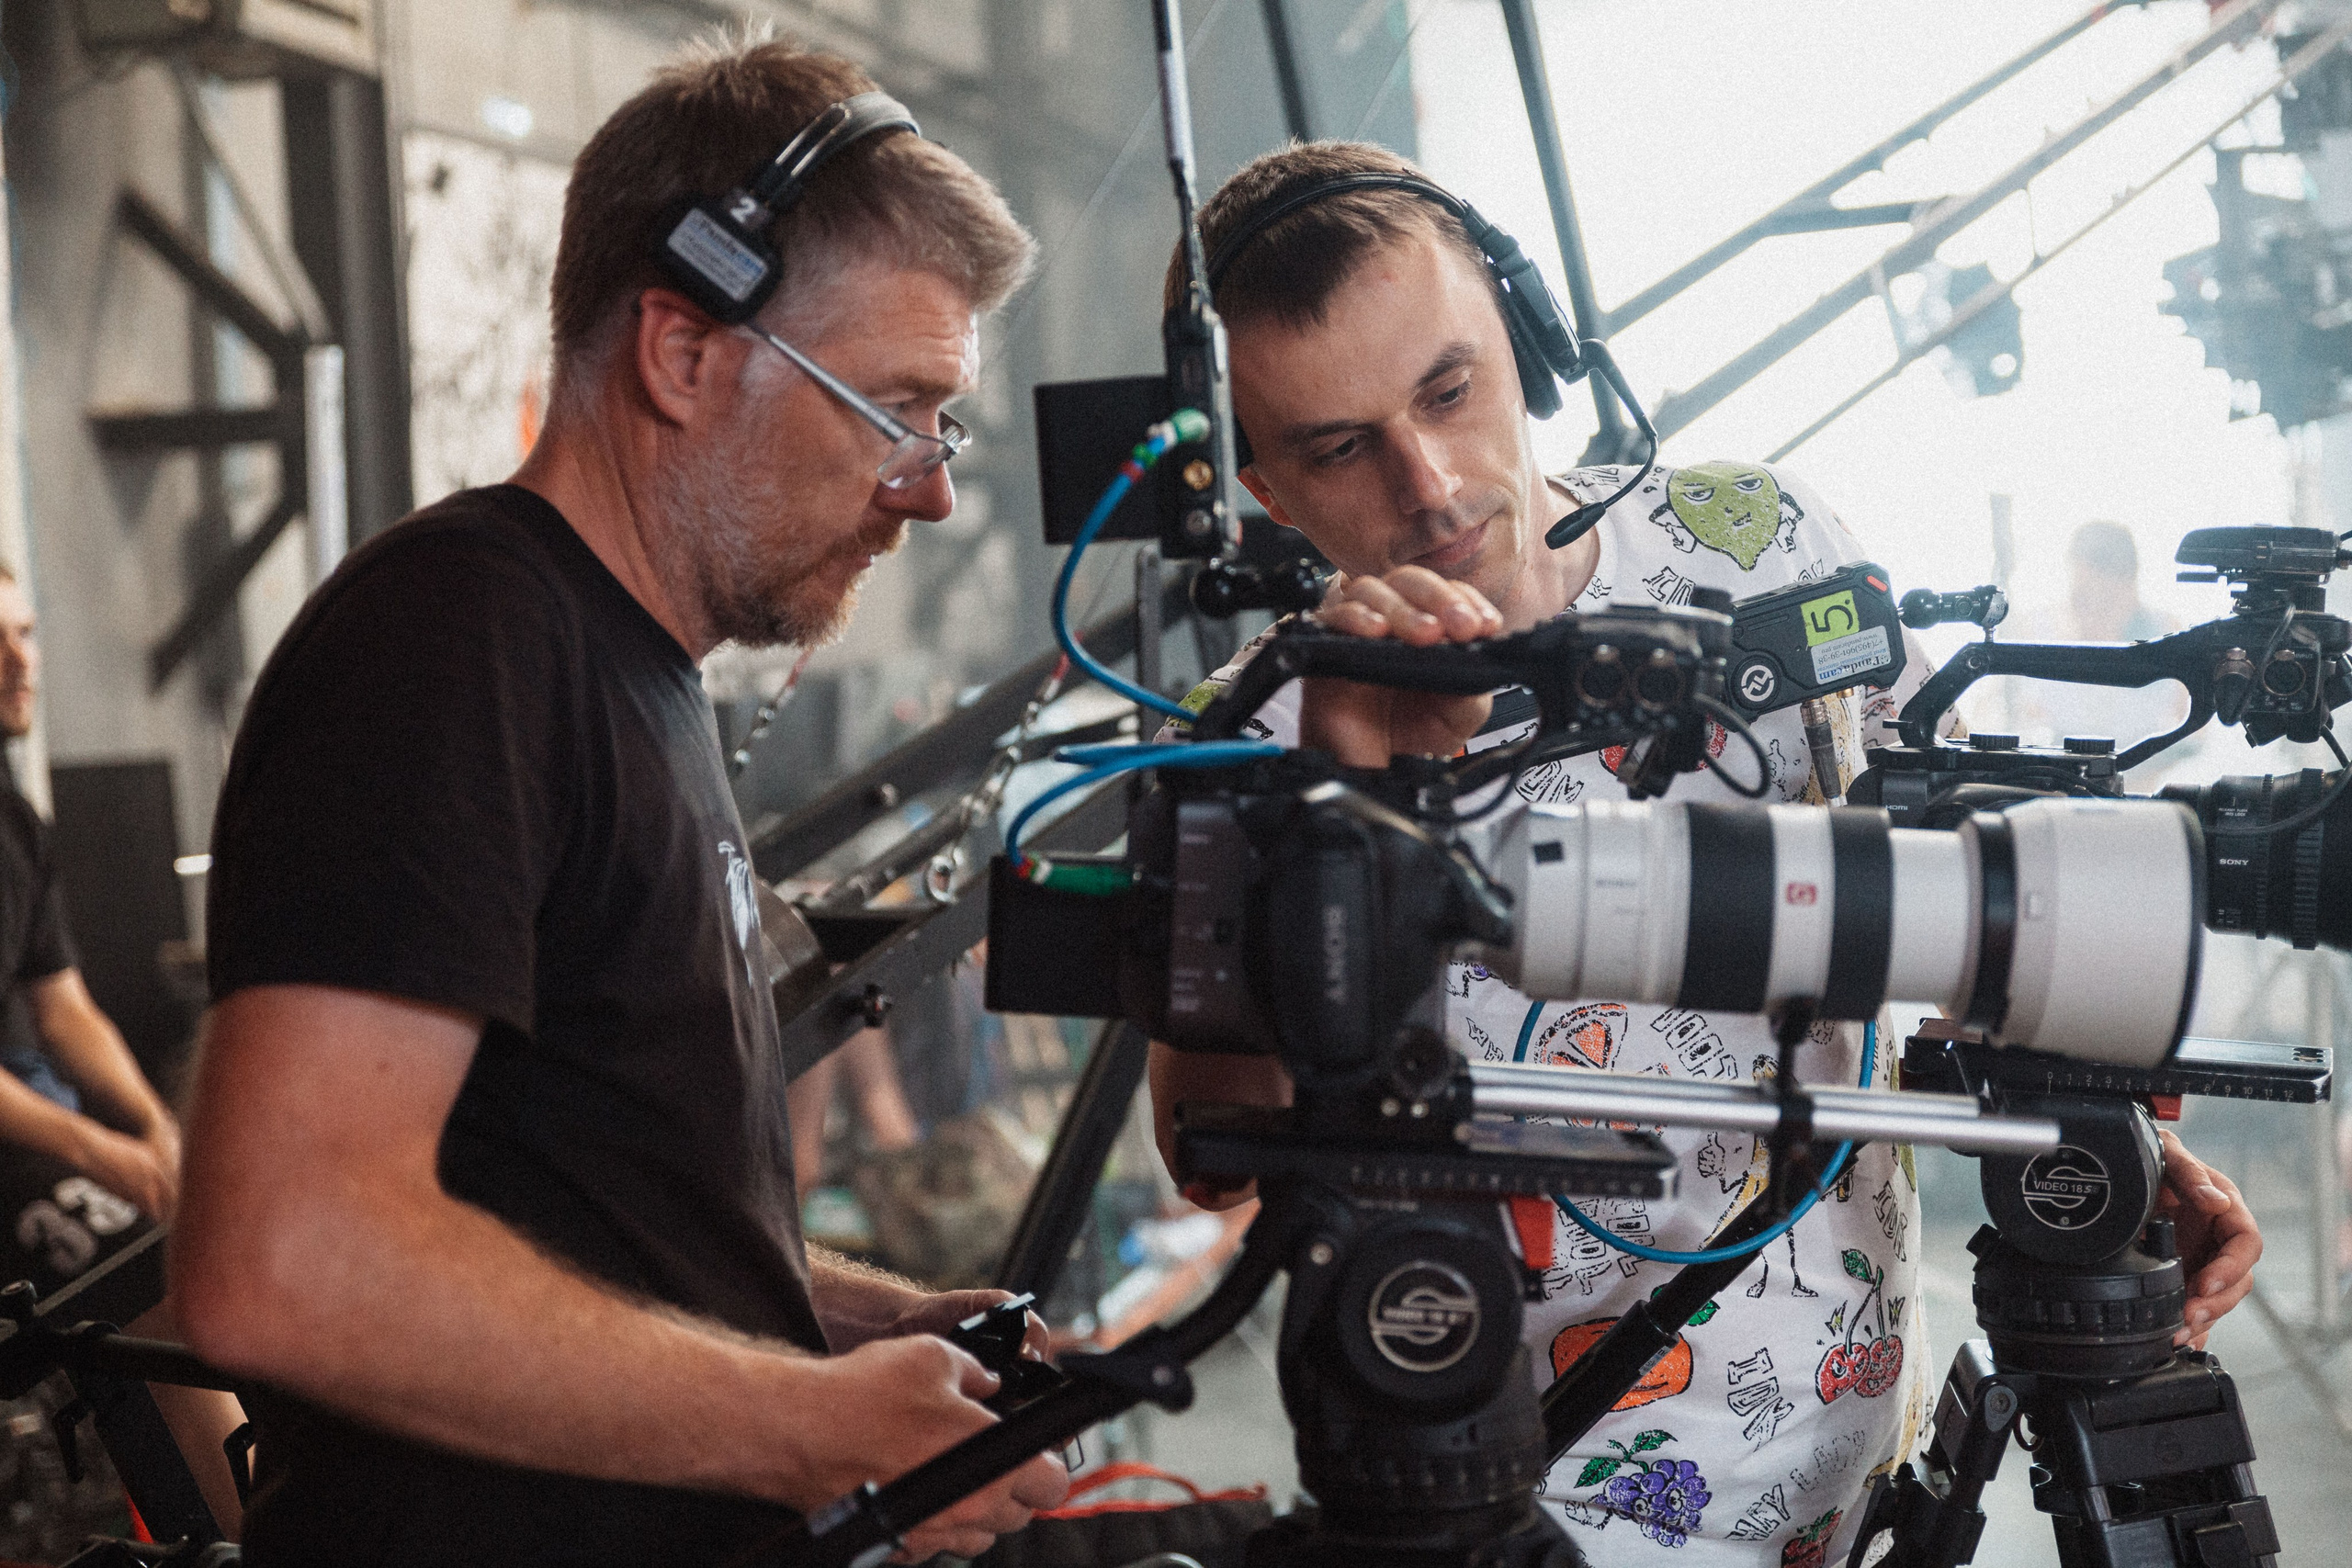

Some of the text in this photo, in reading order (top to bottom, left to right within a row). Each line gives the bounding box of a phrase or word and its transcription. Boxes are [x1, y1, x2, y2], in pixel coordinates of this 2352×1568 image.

[729, 196, 756, 223] 2
[1818, 639, 1883, 665] +7(495)961-39-38
[2219, 858, 2249, 866] SONY
[2033, 1180, 2069, 1192] VIDEO
[1727, 1347, 1795, 1452] IDK
